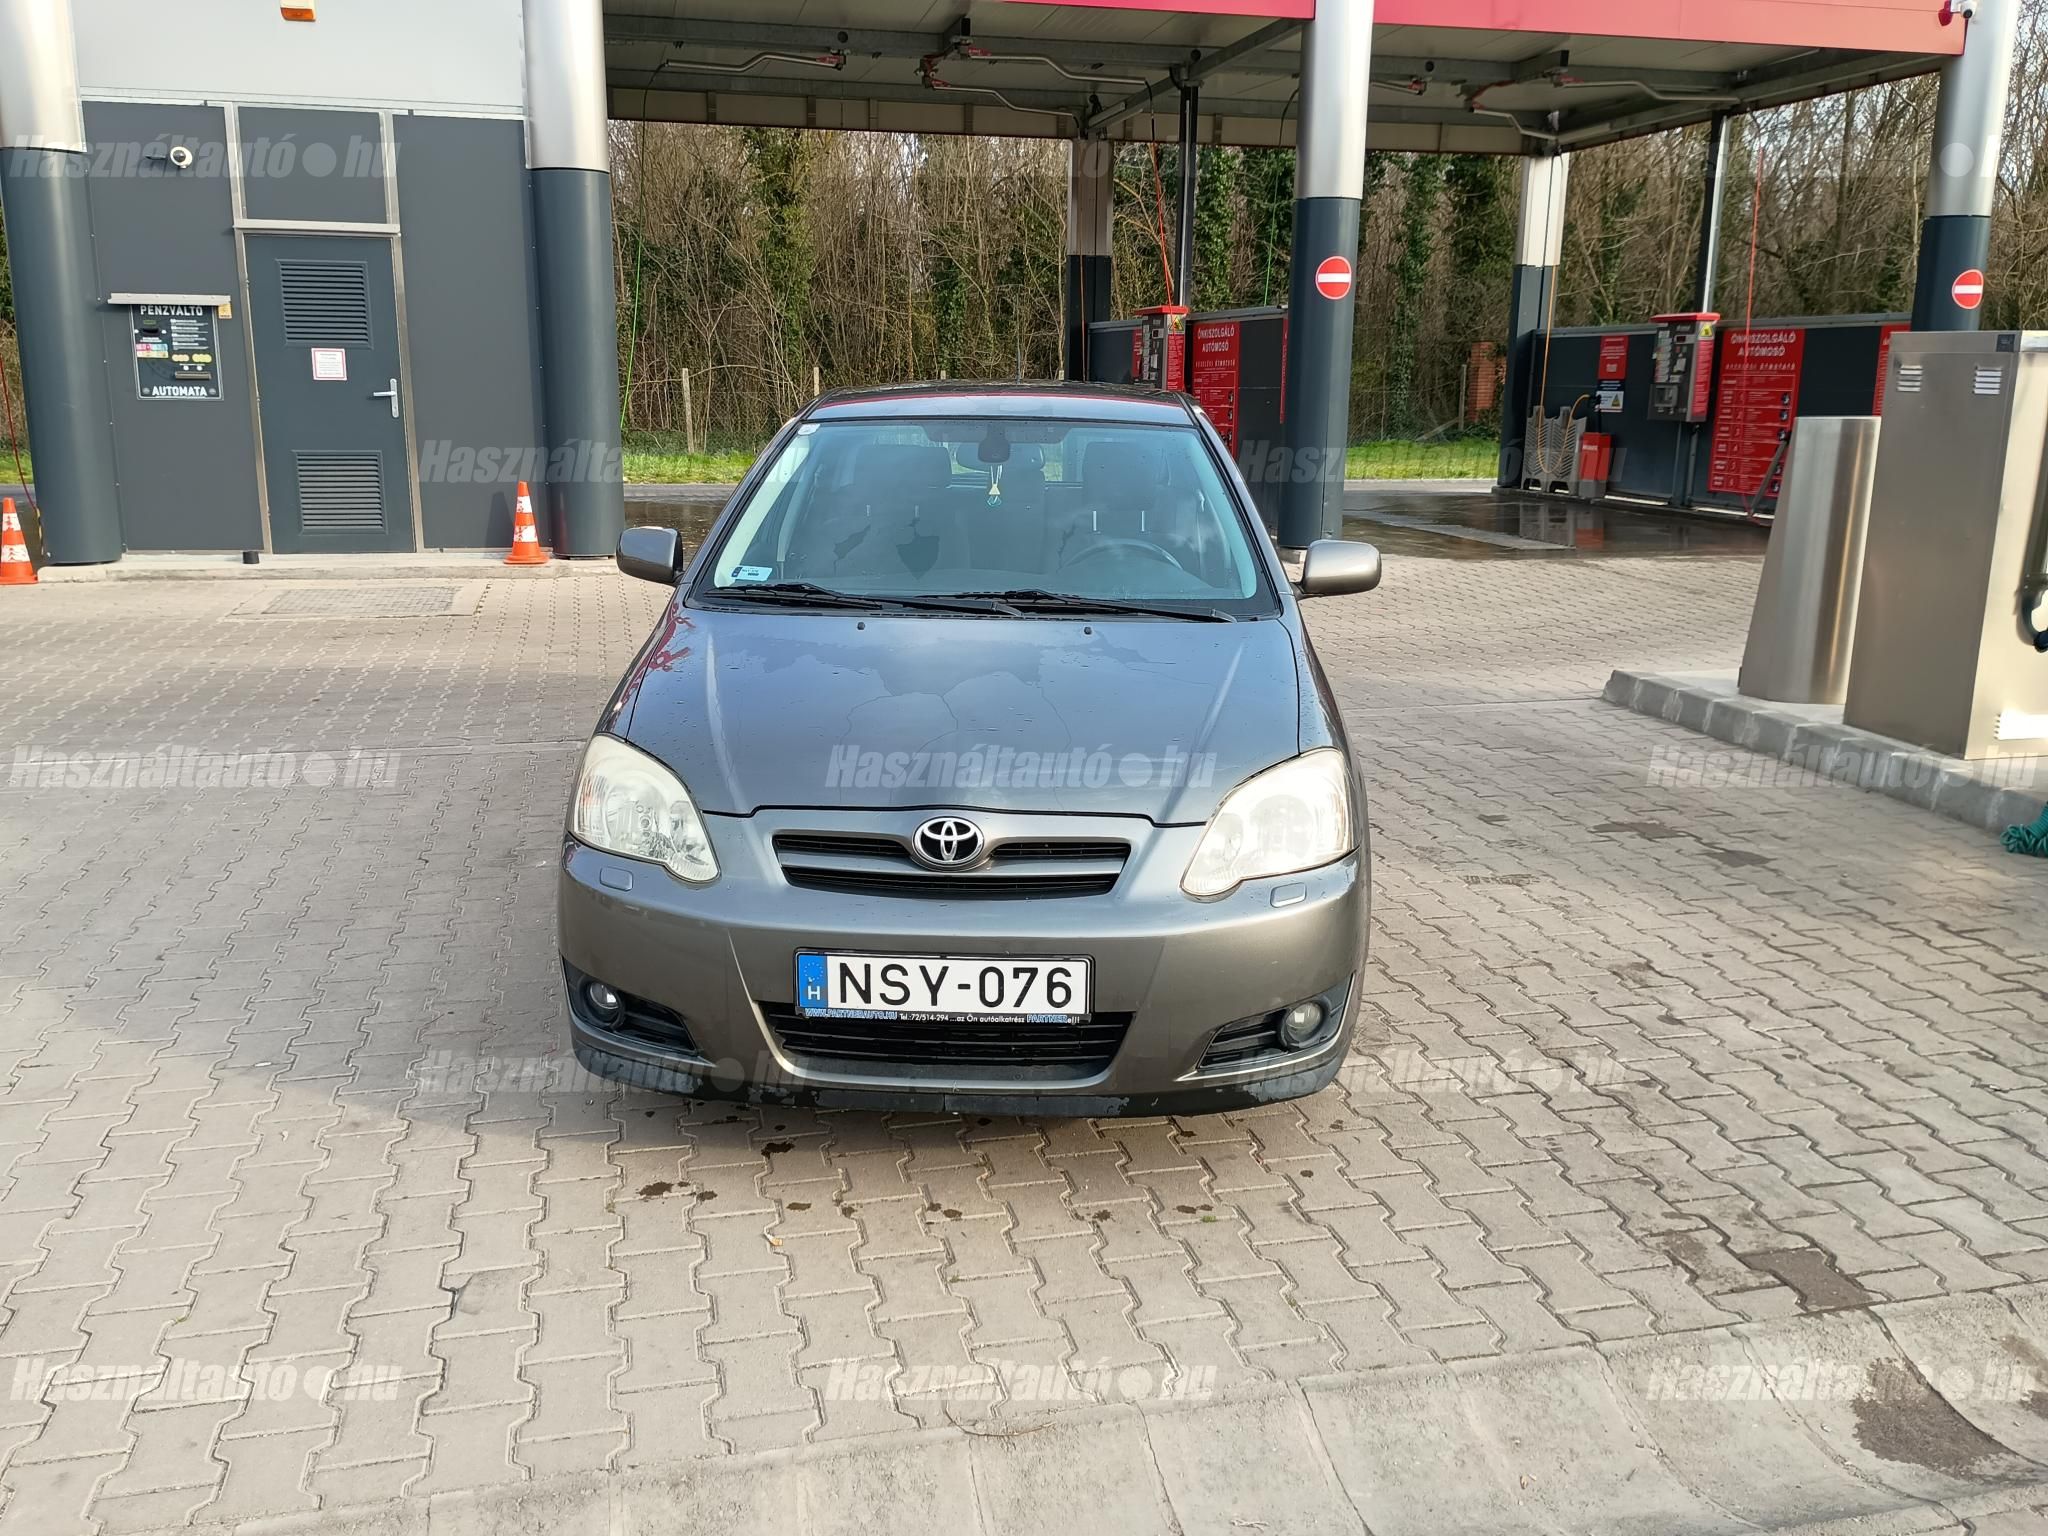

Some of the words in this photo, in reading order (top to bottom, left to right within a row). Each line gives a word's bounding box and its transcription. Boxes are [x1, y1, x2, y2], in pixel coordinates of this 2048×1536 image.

[152, 385, 208, 397] AUTOMATA
[807, 985, 821, 1000] H
[839, 962, 1073, 1008] NSY-076
